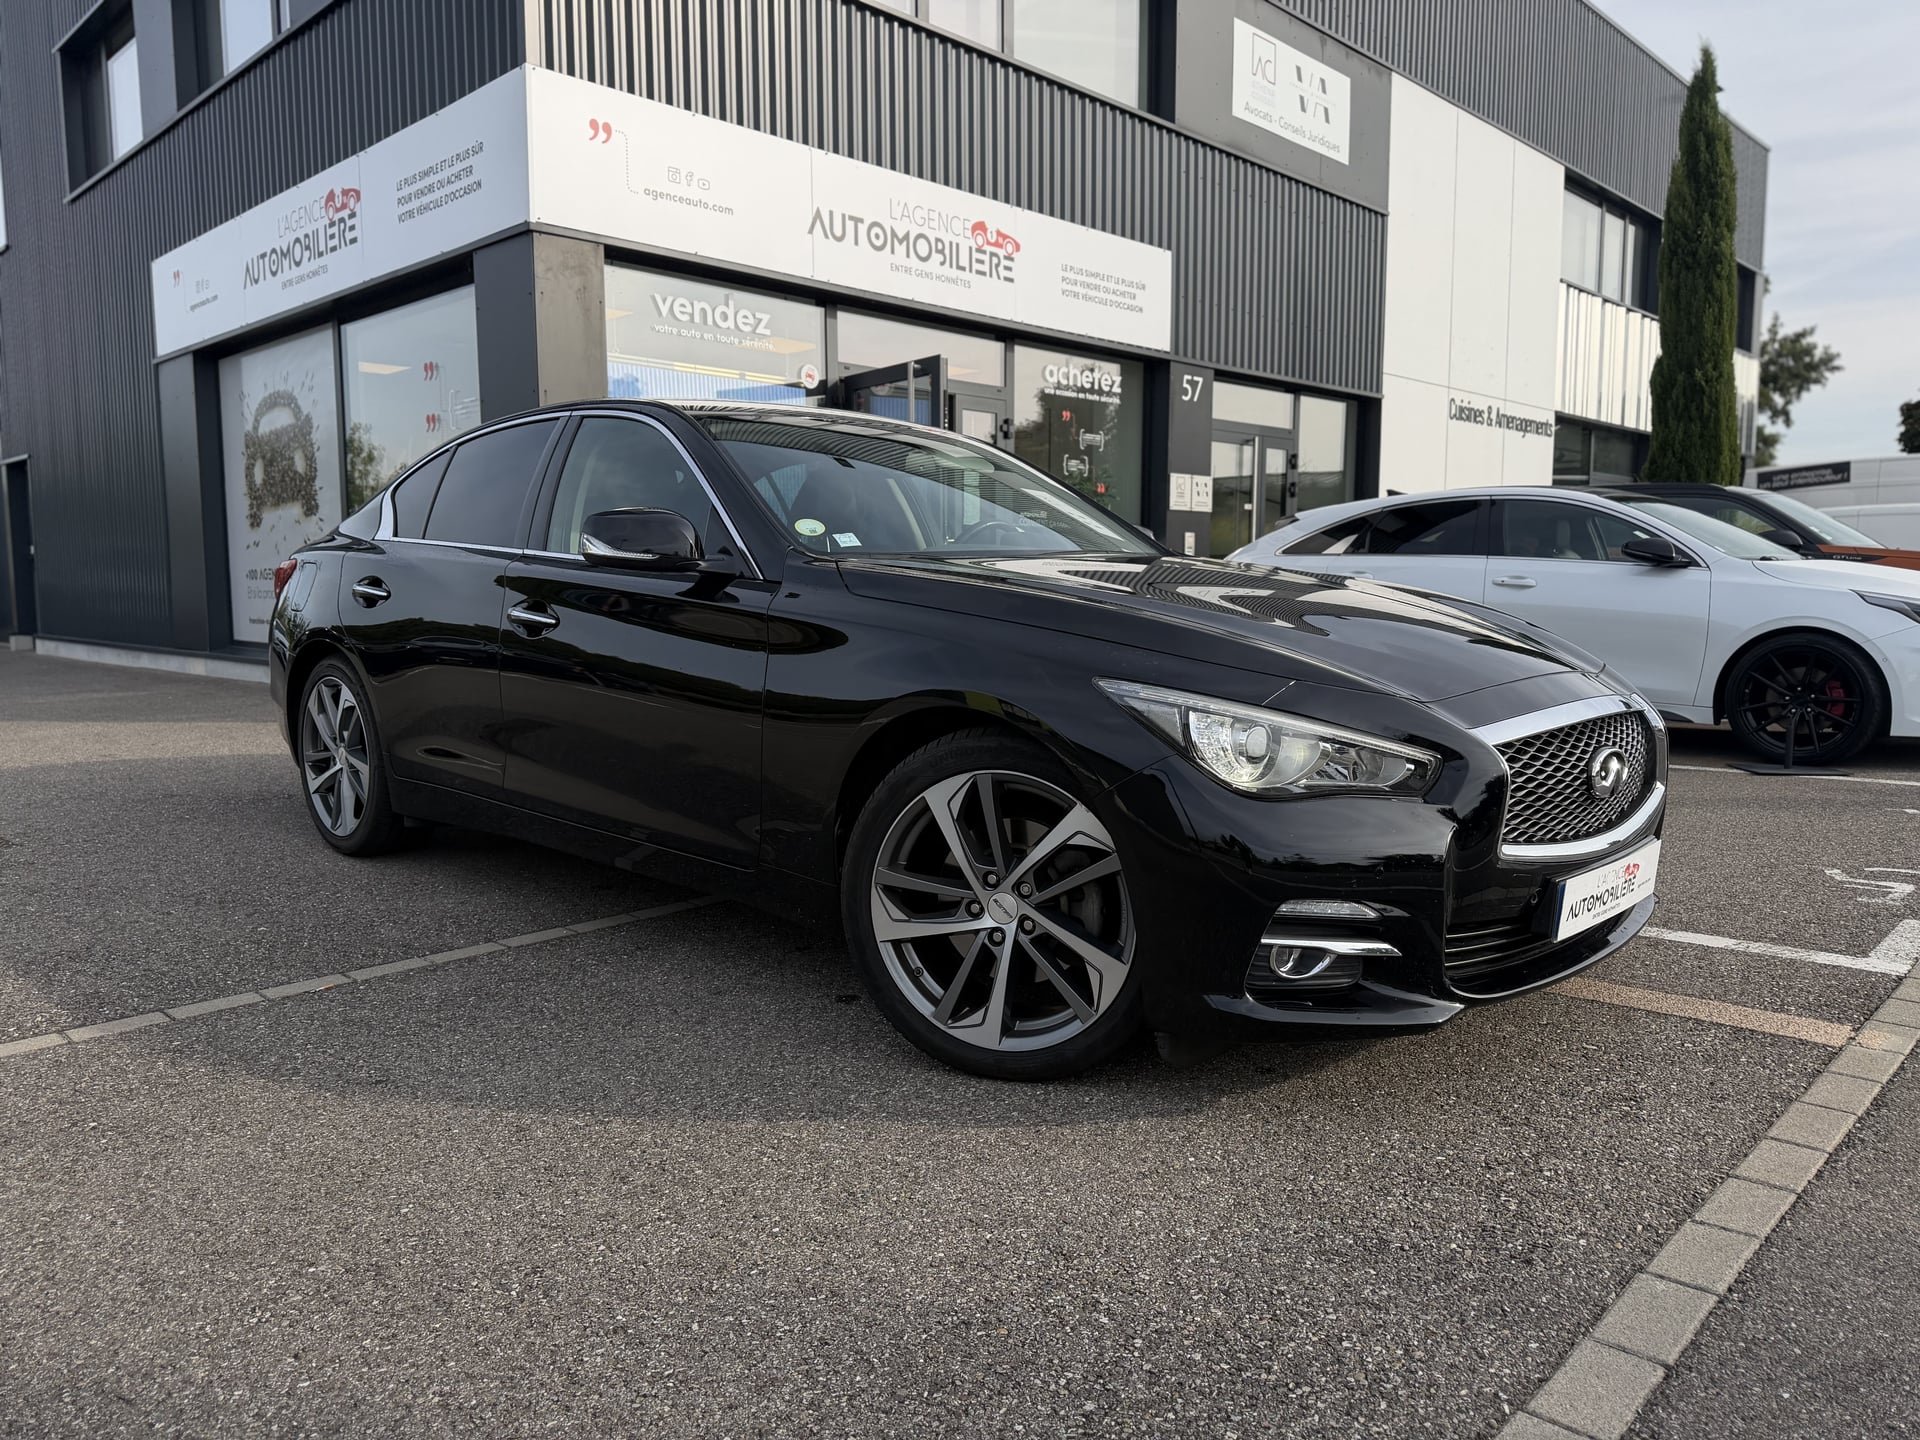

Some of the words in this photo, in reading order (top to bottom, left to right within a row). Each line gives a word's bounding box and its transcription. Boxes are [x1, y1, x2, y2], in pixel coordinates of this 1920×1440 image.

[1244, 101, 1272, 123] Avocats
[1278, 116, 1306, 138] Conseils
[1307, 130, 1340, 153] Juridiques
[397, 180, 402, 191] LE
[404, 173, 417, 188] PLUS
[418, 163, 439, 181] SIMPLE
[440, 158, 447, 172] ET
[448, 156, 454, 168] LE
[456, 148, 470, 164] PLUS
[472, 140, 484, 157] SÛR
[397, 193, 412, 208] POUR
[414, 182, 435, 200] VENDRE
[436, 178, 446, 191] OU
[446, 165, 473, 187] ACHETER
[397, 208, 415, 224] VOTRE
[416, 196, 443, 216] VÉHICULE
[444, 179, 482, 205] D'OCCASION
[643, 187, 734, 216] agenceauto.com
[277, 196, 326, 238] L'AGENCE
[890, 198, 971, 240] L'AGENCE
[890, 262, 913, 276] ENTRE
[915, 269, 934, 281] GENS
[935, 272, 971, 289] HONNÊTES
[1061, 263, 1068, 272] LE
[1069, 265, 1084, 276] PLUS
[1085, 269, 1105, 282] SIMPLE
[1106, 274, 1113, 283] ET
[1114, 276, 1120, 285] LE
[1121, 278, 1134, 288] PLUS
[1062, 276, 1078, 286] POUR
[1079, 280, 1101, 293] VENDRE
[1102, 286, 1111, 295] OU
[1112, 288, 1136, 300] ACHETER
[653, 292, 771, 336] vendez
[1061, 288, 1080, 300] VOTRE
[1081, 291, 1108, 306] VÉHICULE
[1109, 300, 1143, 313] D'OCCASION
[655, 324, 677, 335] votre
[681, 328, 700, 338] auto
[704, 333, 714, 341] en
[717, 334, 738, 346] toute
[1044, 363, 1122, 393] achetez
[1182, 374, 1203, 402] 57
[1449, 397, 1485, 426] Cuisines
[1486, 405, 1493, 426] &
[1495, 406, 1553, 438] Amenagements
